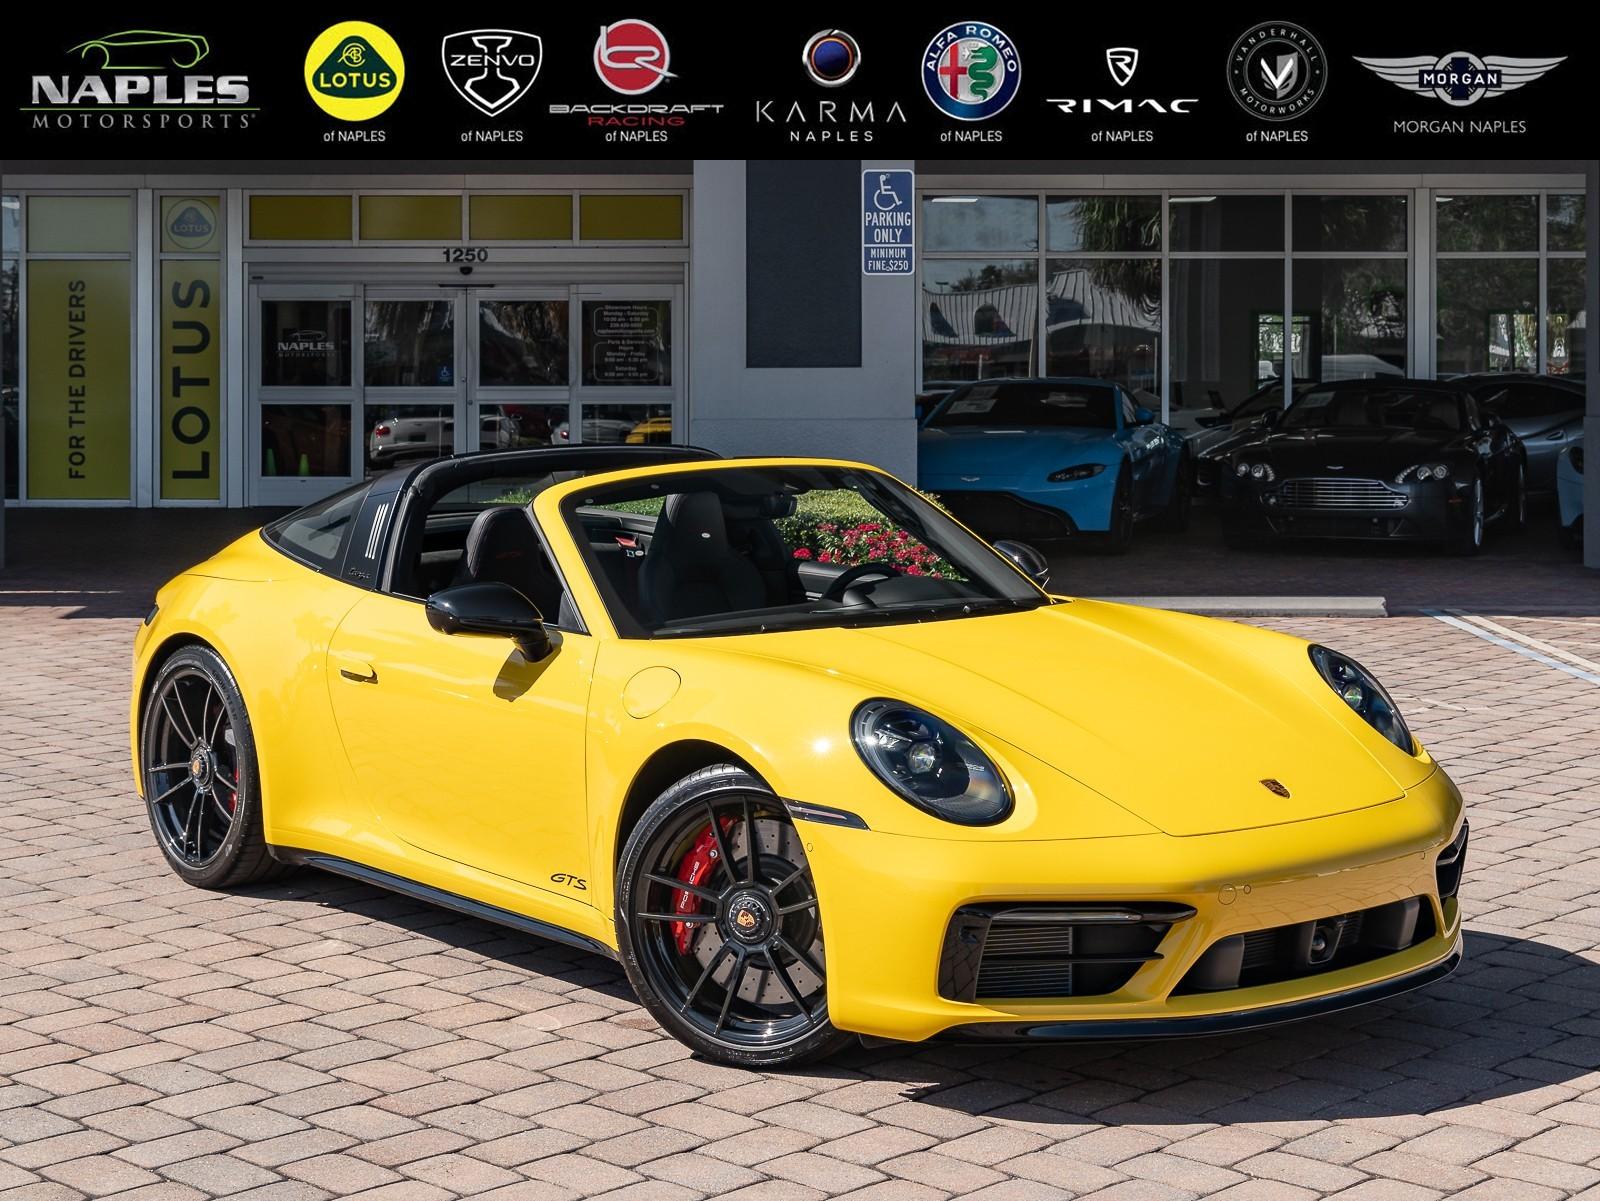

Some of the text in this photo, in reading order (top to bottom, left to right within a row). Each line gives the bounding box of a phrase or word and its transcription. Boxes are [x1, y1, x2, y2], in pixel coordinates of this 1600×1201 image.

[865, 211, 912, 226] PARKING
[174, 223, 209, 233] LOTUS
[874, 228, 903, 243] ONLY
[442, 247, 488, 263] 1250
[870, 248, 907, 259] MINIMUM
[868, 259, 909, 272] FINE $250
[278, 342, 335, 351] NAPLES
[68, 279, 86, 480] FOR THE DRIVERS
[171, 279, 212, 480] LOTUS
[550, 873, 587, 891] GTS
